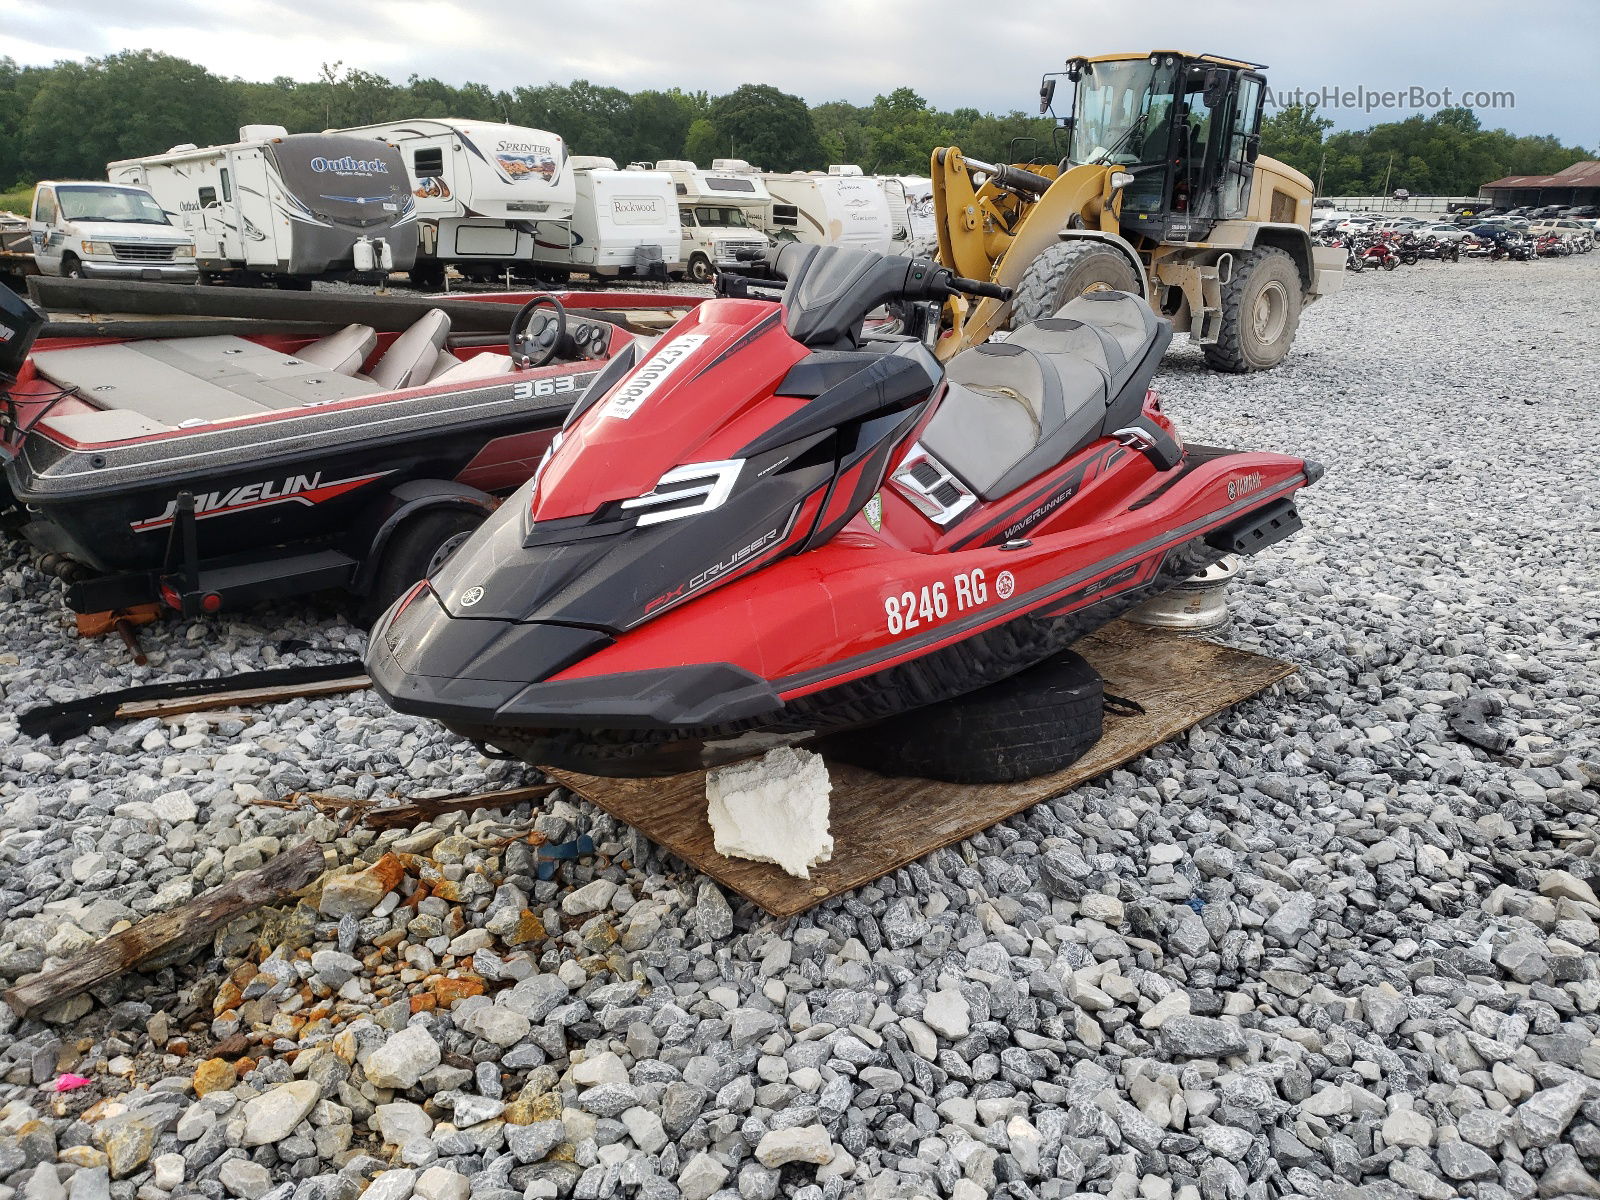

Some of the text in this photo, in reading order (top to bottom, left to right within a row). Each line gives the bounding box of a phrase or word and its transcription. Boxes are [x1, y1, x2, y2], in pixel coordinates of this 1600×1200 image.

[496, 141, 551, 155] SPRINTER
[310, 156, 389, 174] Outback
[614, 201, 656, 212] Rockwood
[514, 375, 575, 400] 363
[1235, 471, 1262, 496] YAMAHA
[644, 528, 777, 613] FX CRUISER
[884, 581, 948, 635] 8246
[953, 567, 988, 611] RG
